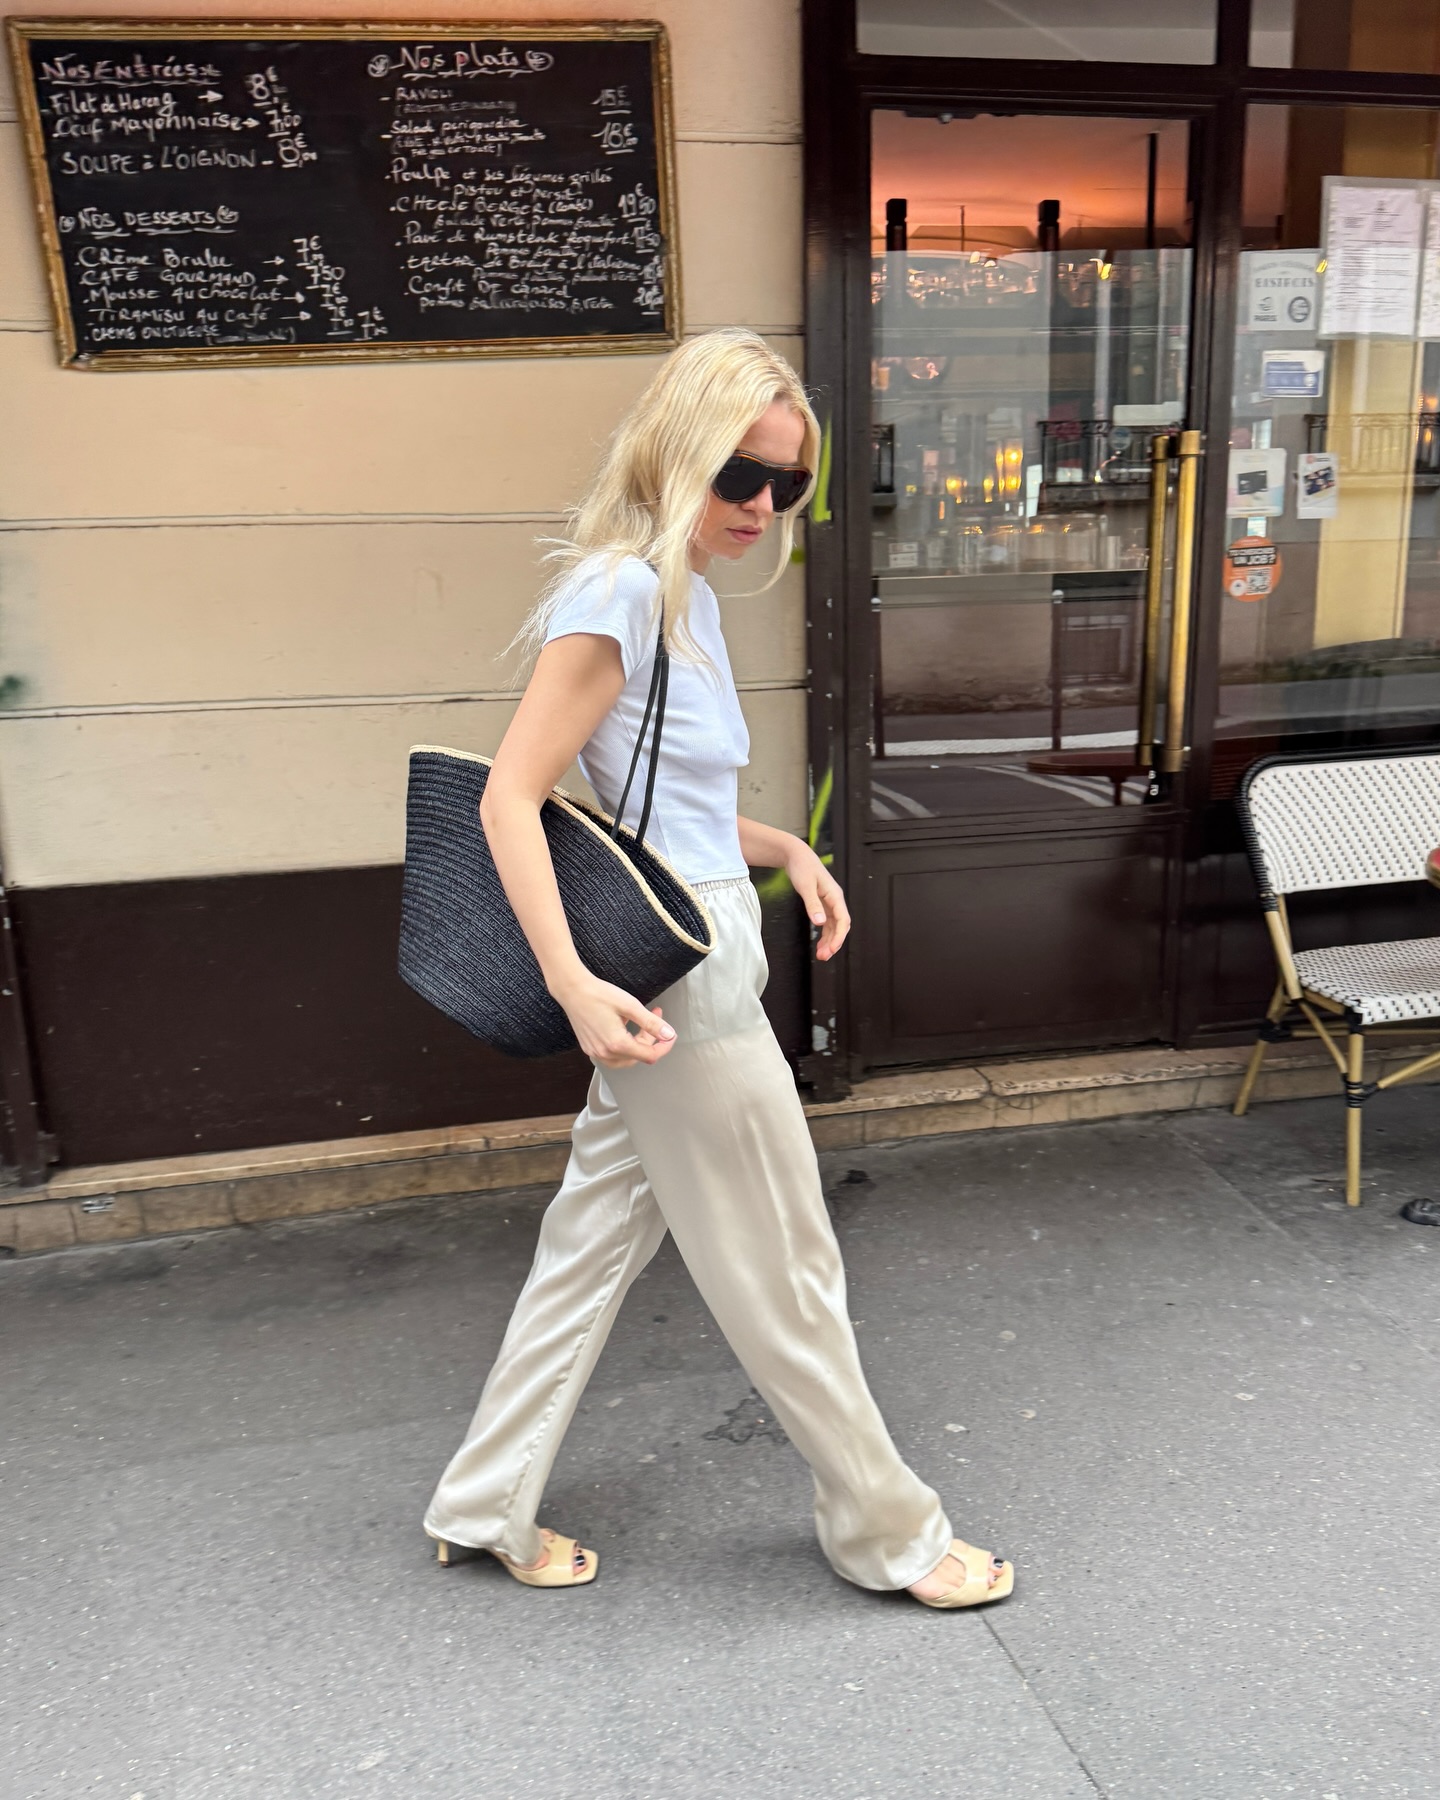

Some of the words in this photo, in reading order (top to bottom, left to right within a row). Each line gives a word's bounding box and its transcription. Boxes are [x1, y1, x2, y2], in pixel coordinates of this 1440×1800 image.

[401, 44, 446, 72] Nos
[455, 43, 520, 77] plats
[49, 90, 98, 115] Filet
[61, 152, 140, 175] SOUPE
[391, 157, 451, 188] Poulpe
[123, 211, 216, 227] DESSERTS
